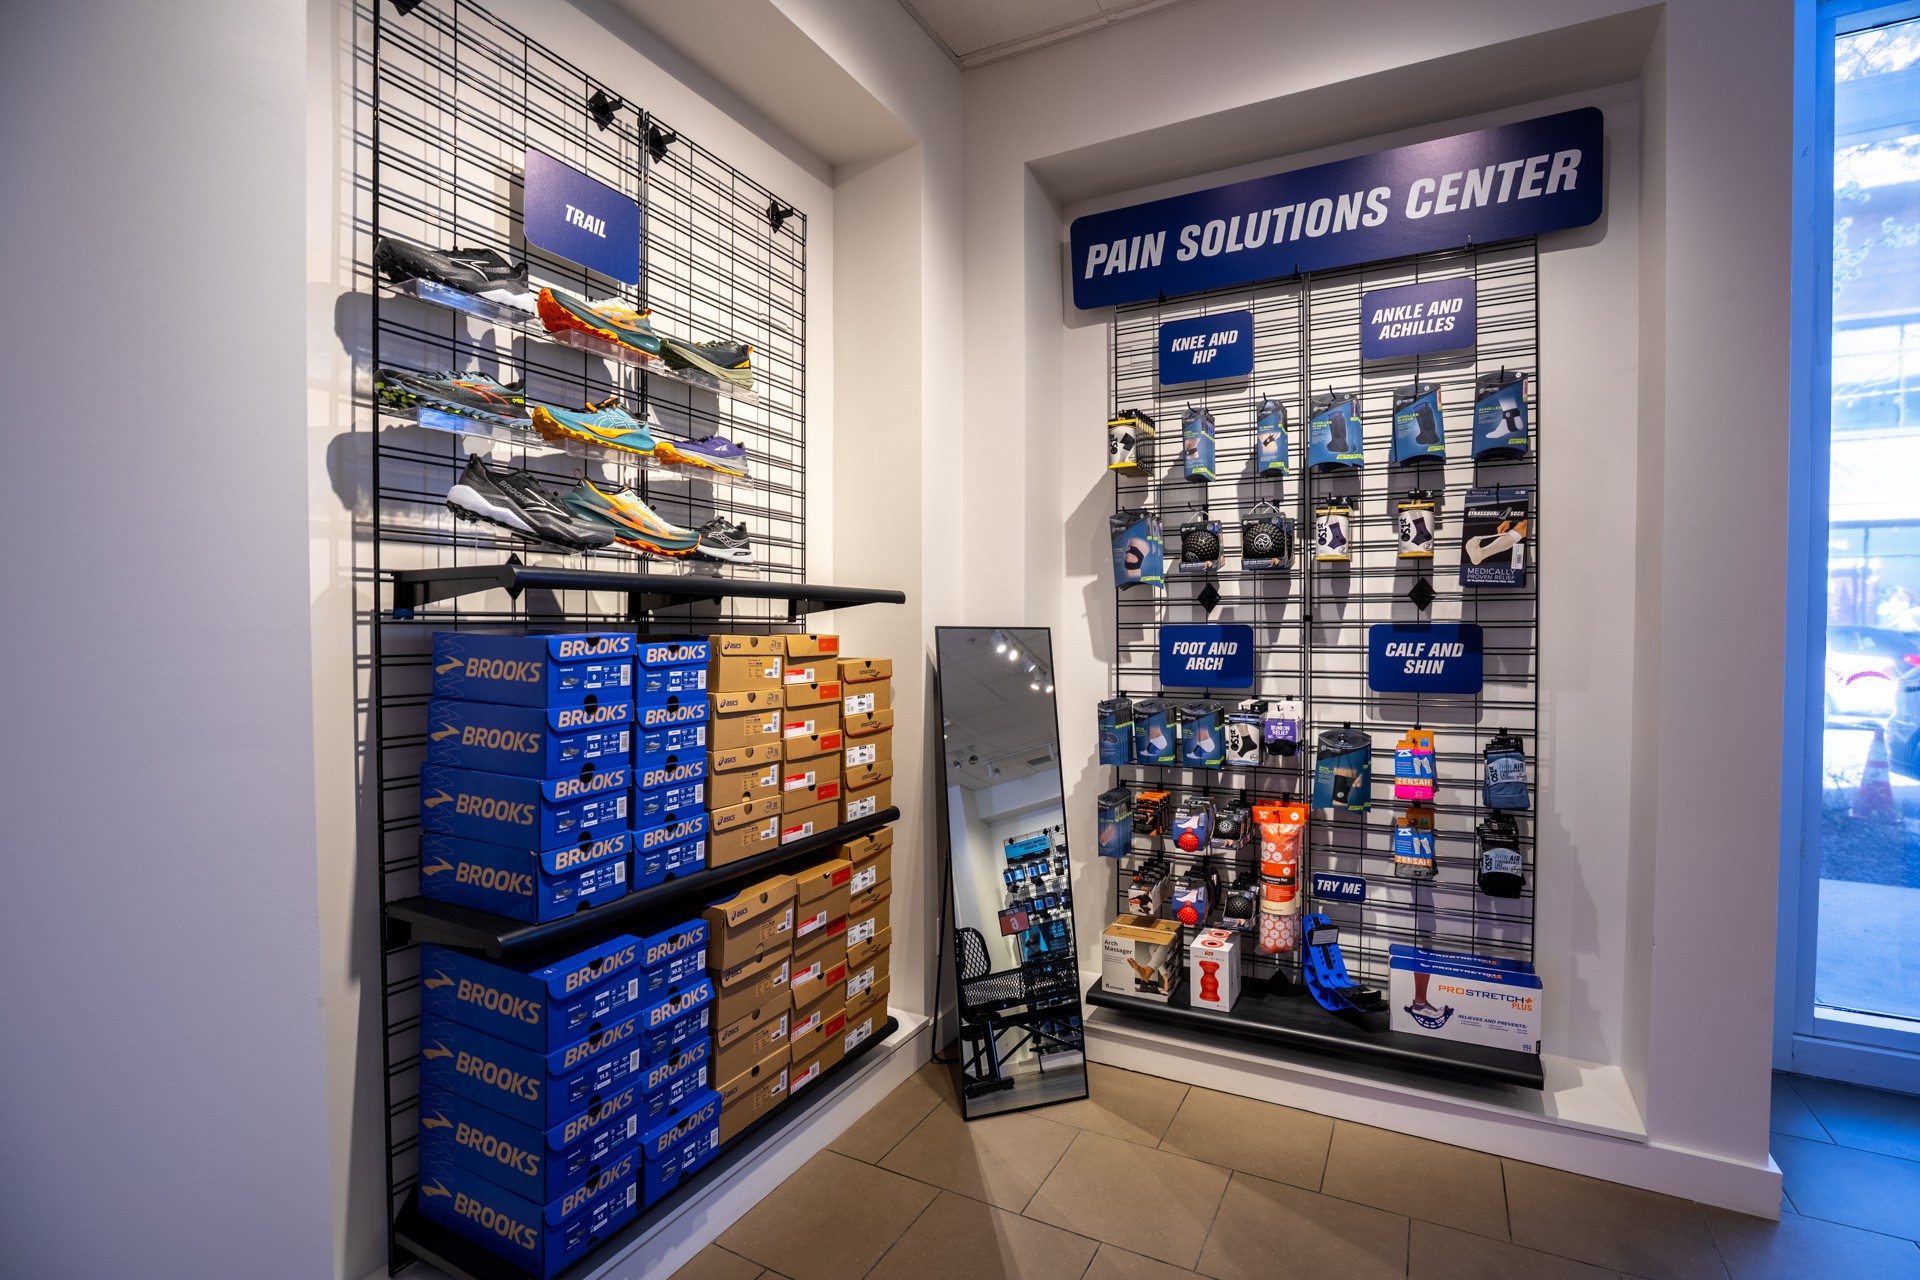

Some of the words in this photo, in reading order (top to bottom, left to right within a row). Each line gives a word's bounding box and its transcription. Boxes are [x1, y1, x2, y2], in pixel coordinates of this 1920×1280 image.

[566, 204, 606, 238] TRAIL
[1084, 231, 1166, 280] PAIN
[1176, 186, 1391, 262] SOLUTIONS
[1406, 148, 1582, 219] CENTER
[1371, 304, 1424, 324] ANKLE
[1427, 298, 1463, 316] AND
[1378, 316, 1456, 340] ACHILLES
[1172, 334, 1206, 352] KNEE
[1208, 330, 1238, 346] AND
[1192, 349, 1217, 364] HIP
[1172, 642, 1206, 655] FOOT
[1208, 642, 1238, 655] AND
[1385, 643, 1425, 657] CALF
[1428, 643, 1464, 657] AND
[466, 658, 542, 682] BROOKS
[1185, 658, 1224, 670] ARCH
[1404, 660, 1444, 674] SHIN
[462, 726, 542, 754] BROOKS
[456, 794, 536, 826] BROOKS
[456, 862, 534, 896] BROOKS
[582, 878, 594, 887] 10.5
[1317, 880, 1340, 892] TRY
[1342, 882, 1362, 894] ME
[1104, 946, 1132, 955] Massager
[457, 979, 542, 1025] BROOKS
[1512, 1002, 1532, 1012] PLUS
[1498, 1020, 1528, 1029] PREVENTS:
[456, 1051, 540, 1101] BROOKS
[599, 1071, 609, 1081] 11.5
[673, 1088, 682, 1097] 11.5
[456, 1122, 540, 1177] BROOKS
[454, 1192, 538, 1250] BROOKS
